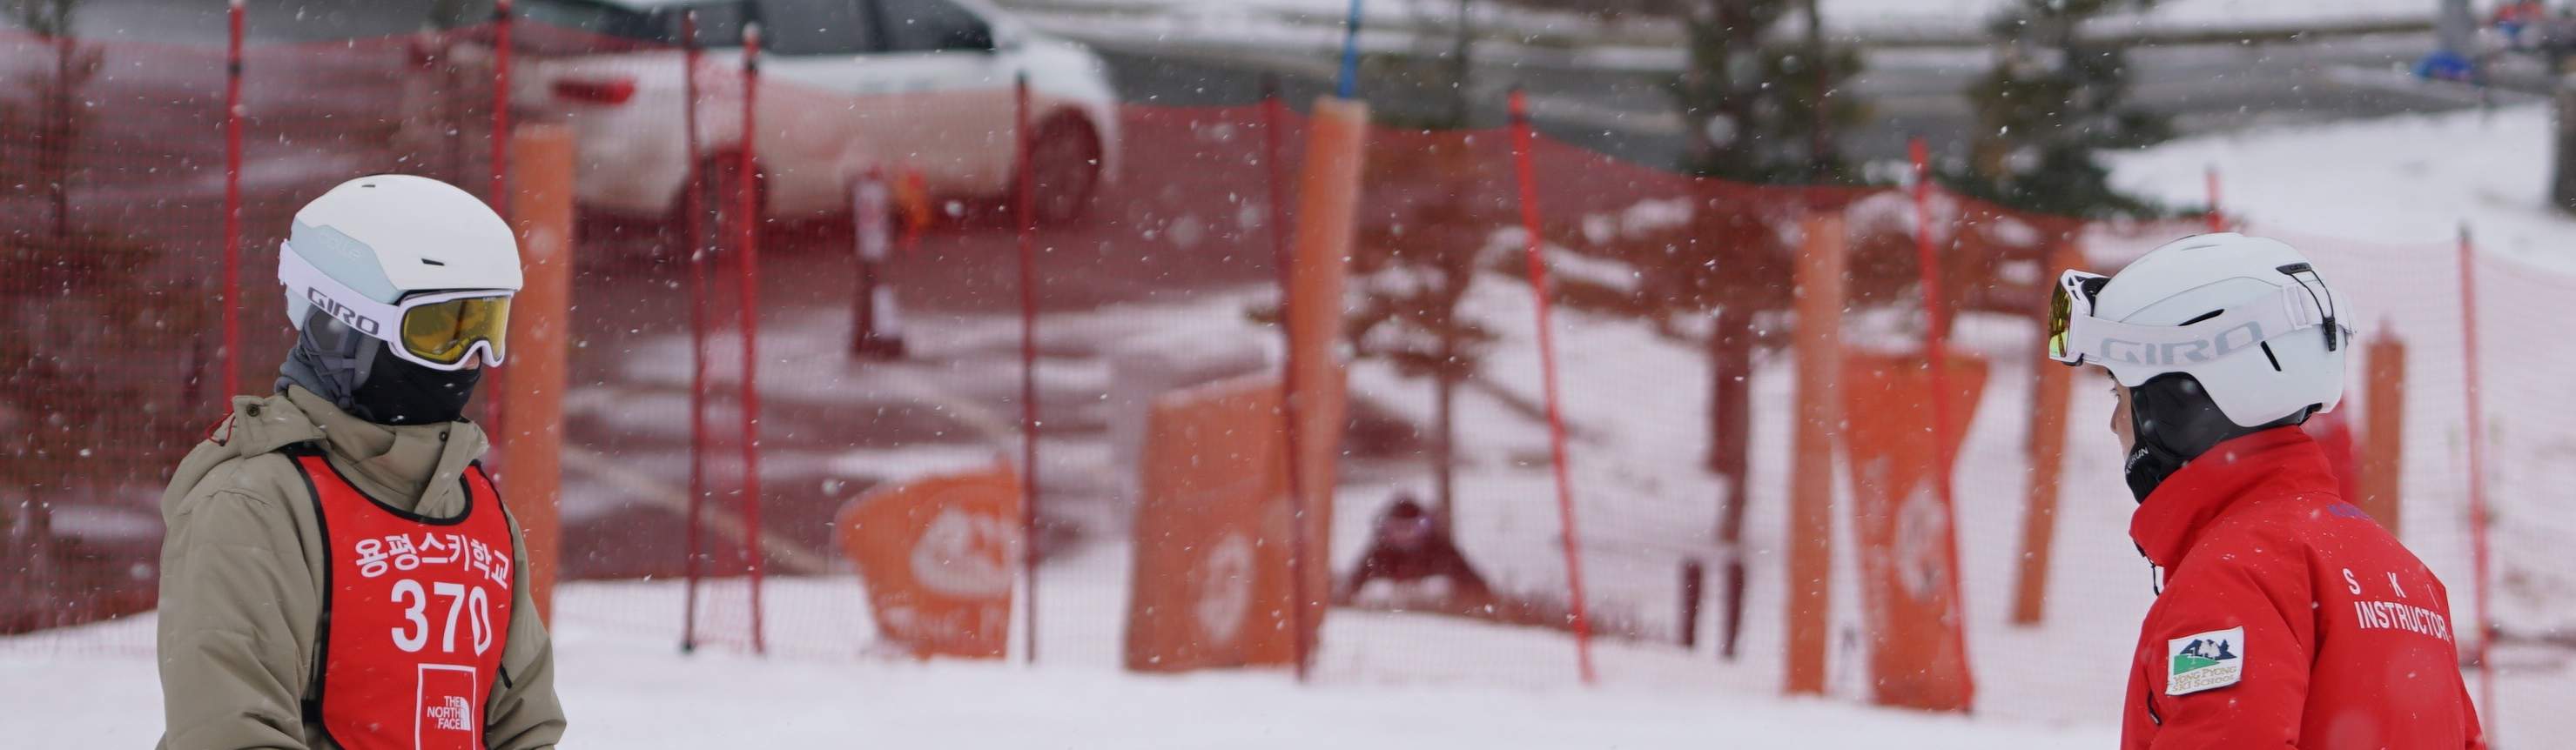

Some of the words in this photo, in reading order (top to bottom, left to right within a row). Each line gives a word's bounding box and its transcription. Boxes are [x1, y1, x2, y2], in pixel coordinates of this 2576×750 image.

[306, 285, 380, 336] GIRO
[2101, 321, 2263, 365] GIRO
[354, 532, 510, 590] 용평스키학교
[391, 579, 492, 657] 370
[2353, 601, 2449, 641] INSTRUCTOR
[427, 706, 461, 719] NORTH
[443, 695, 461, 707] THE
[437, 718, 461, 730] FACE
